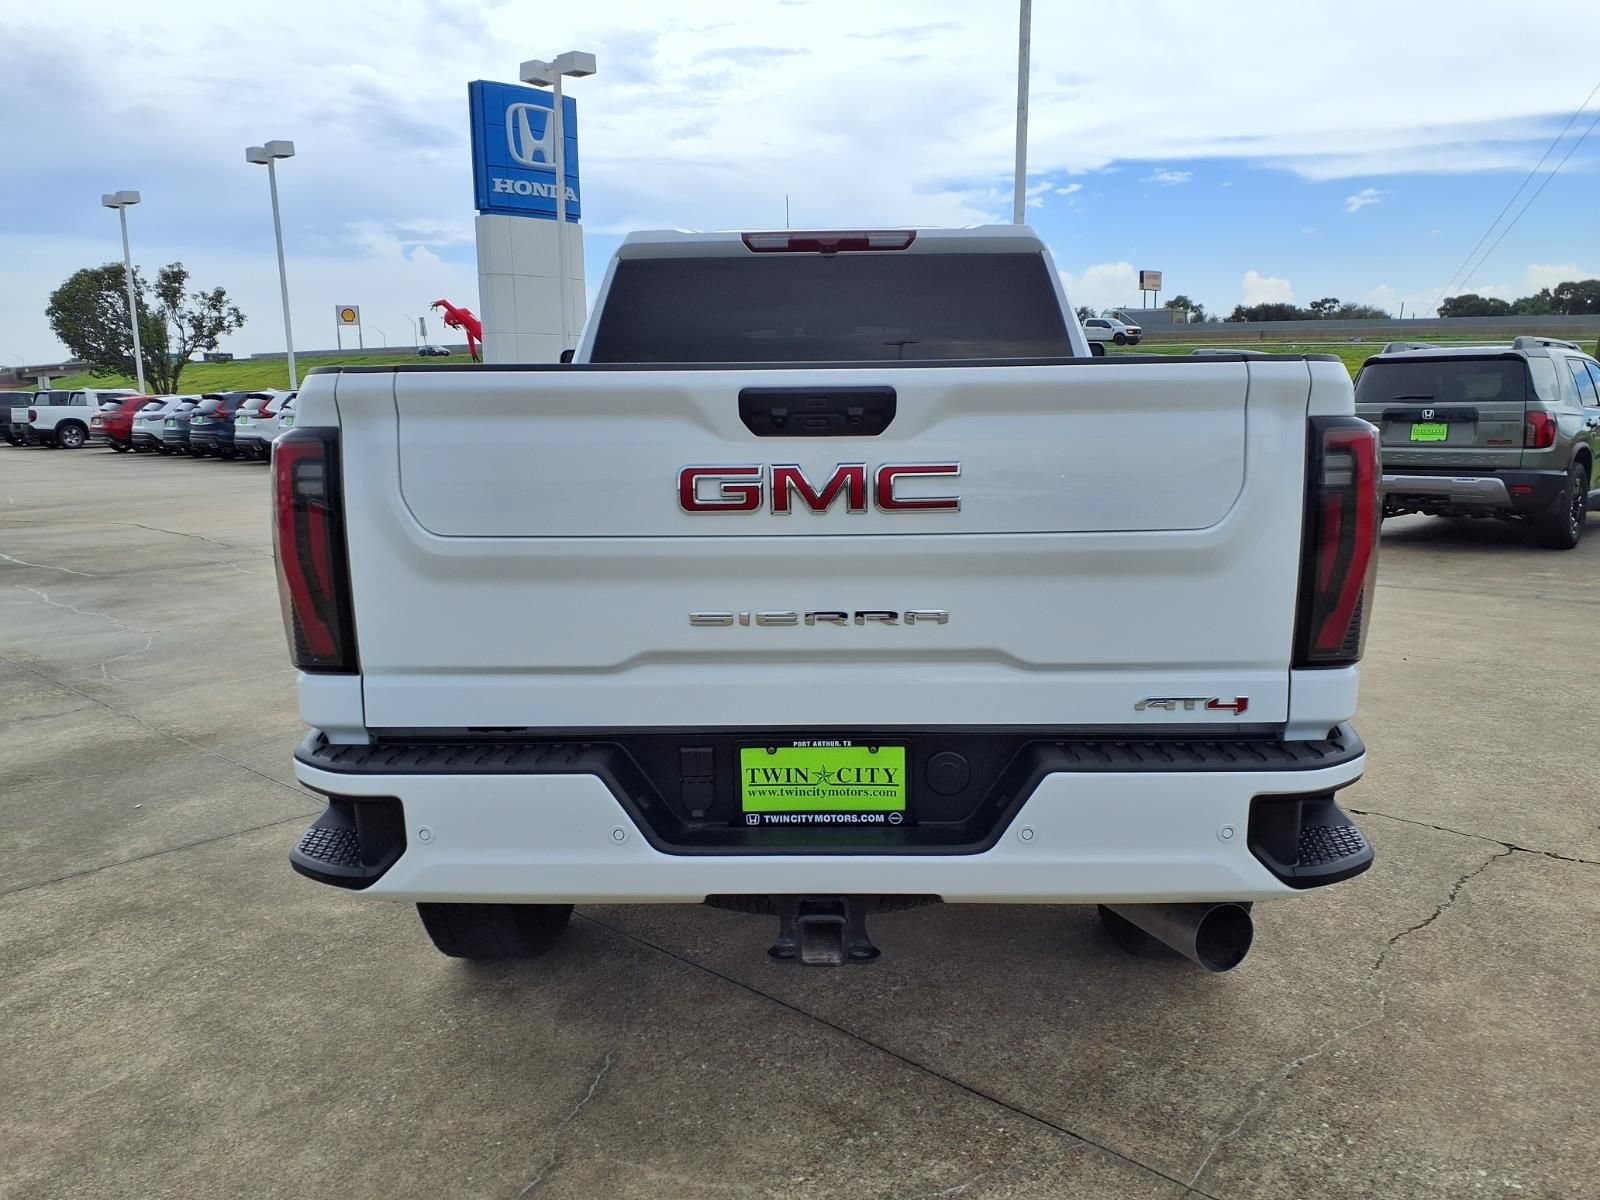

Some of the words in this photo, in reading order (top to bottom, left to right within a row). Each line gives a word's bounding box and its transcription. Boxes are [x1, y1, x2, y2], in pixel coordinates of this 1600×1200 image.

[677, 462, 962, 515] GMC
[688, 609, 950, 627] SIERRA
[1134, 696, 1249, 716] AT4
[793, 740, 811, 748] PORT
[746, 767, 810, 784] TWIN
[836, 767, 898, 784] CITY
[748, 786, 897, 799] www.twincitymotors.com
[764, 813, 885, 824] TWINCITYMOTORS.COM
